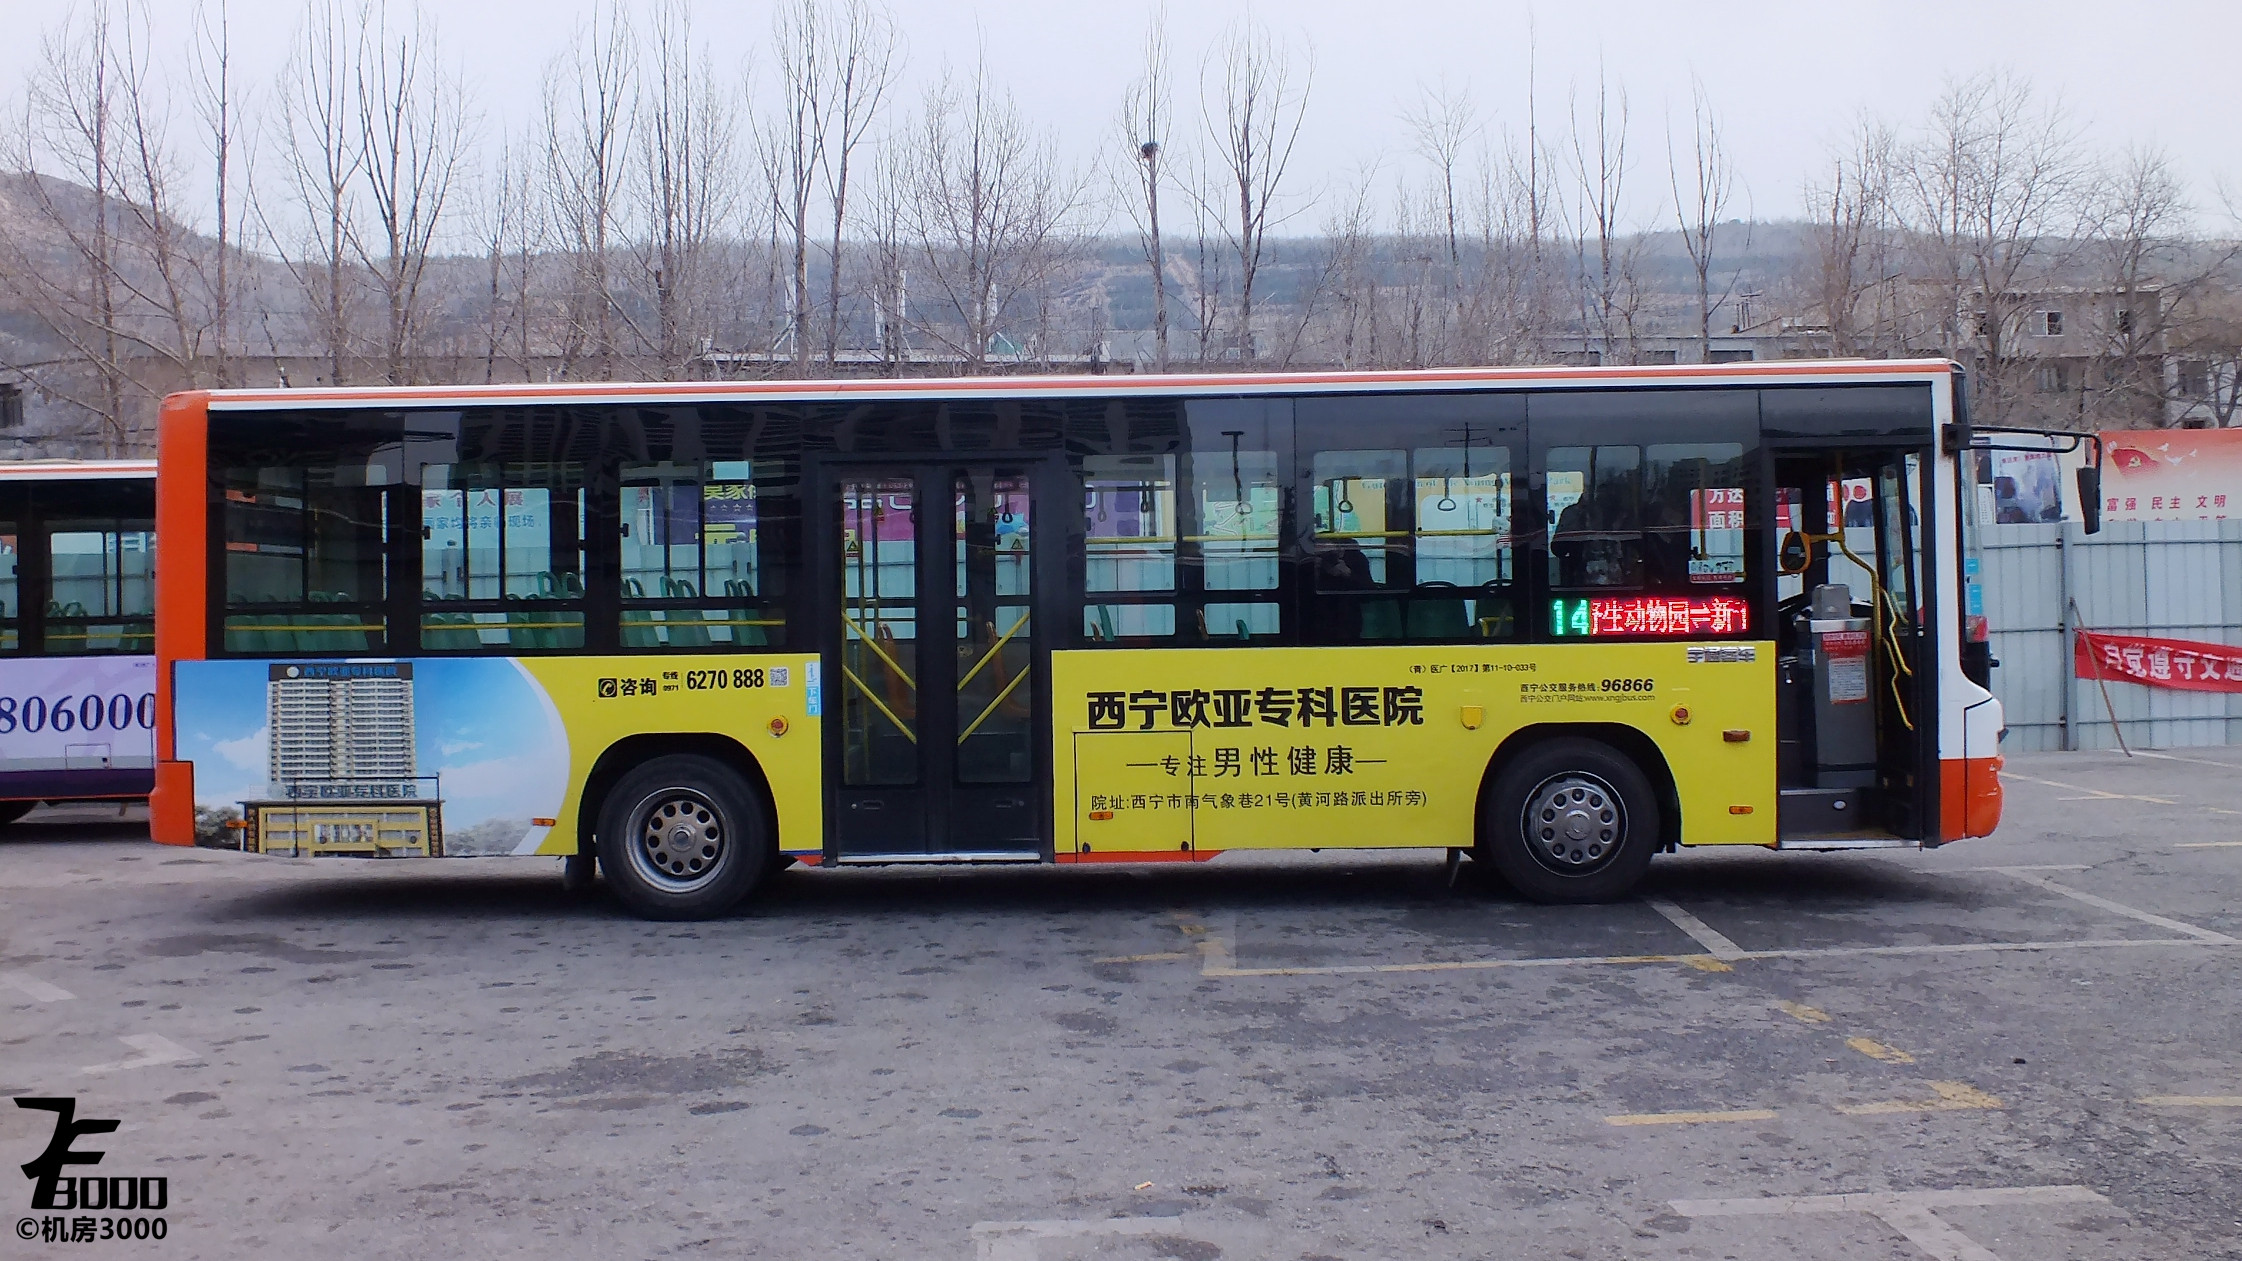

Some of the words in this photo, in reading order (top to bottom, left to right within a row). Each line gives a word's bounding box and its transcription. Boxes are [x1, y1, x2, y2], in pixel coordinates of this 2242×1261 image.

[2107, 498, 2137, 512] 富强
[2151, 496, 2181, 510] 民主
[2196, 494, 2226, 508] 文明
[1554, 600, 1588, 635] 14
[621, 678, 657, 696] 咨询
[687, 670, 728, 690] 6270
[733, 668, 764, 689] 888
[1087, 685, 1425, 730] 西宁欧亚专科医院
